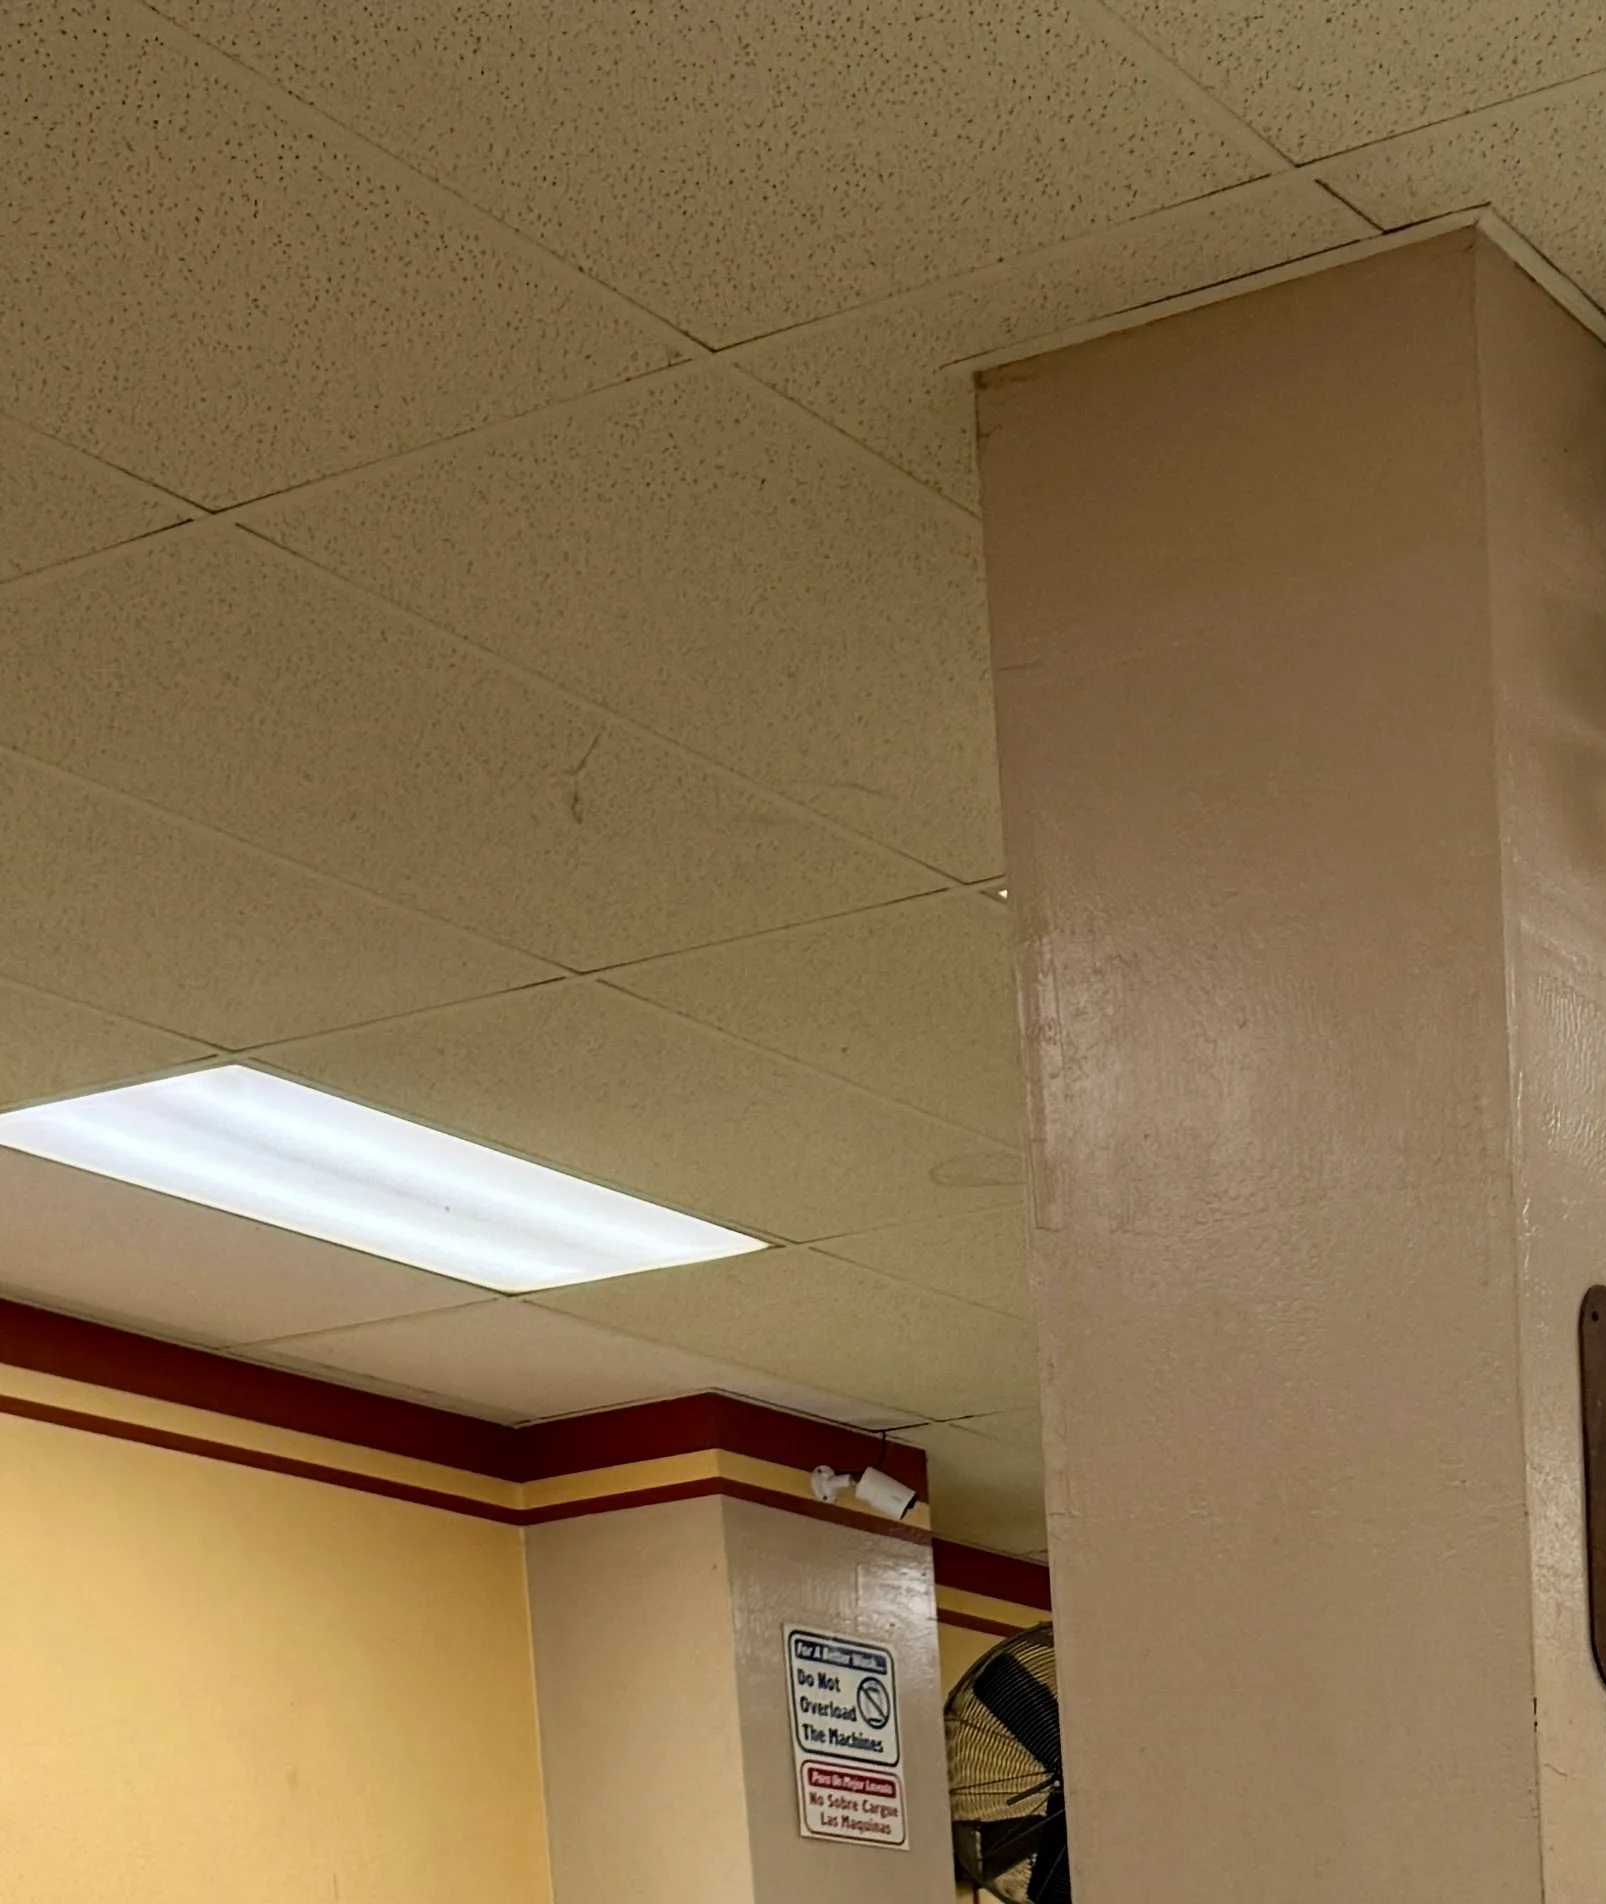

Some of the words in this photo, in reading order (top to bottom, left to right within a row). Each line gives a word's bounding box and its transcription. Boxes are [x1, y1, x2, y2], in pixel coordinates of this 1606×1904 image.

[797, 1668, 814, 1687] Do
[817, 1672, 841, 1693] Not
[800, 1695, 857, 1722] Overload
[802, 1723, 826, 1743] The
[828, 1728, 883, 1753] Machines
[809, 1792, 824, 1807] No
[827, 1793, 858, 1812] Sobre
[862, 1799, 898, 1818] Cargue
[820, 1811, 838, 1828] Las
